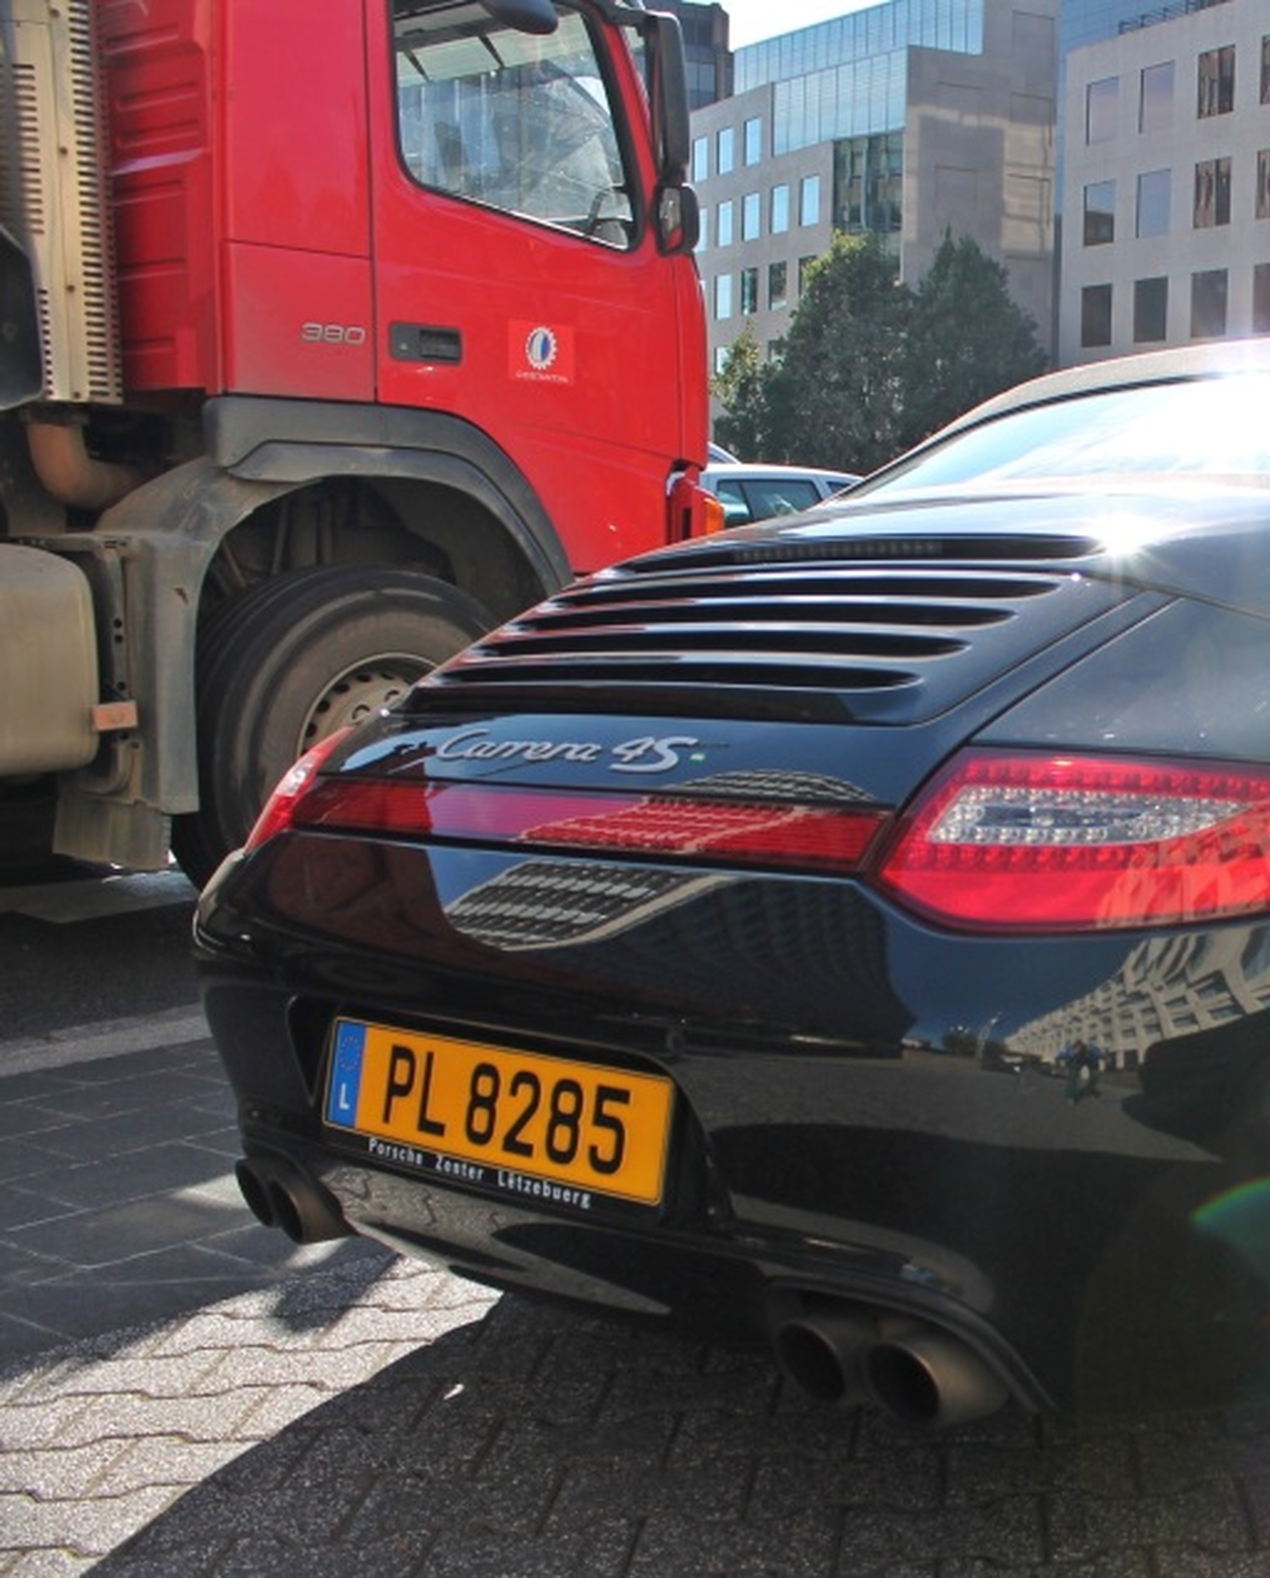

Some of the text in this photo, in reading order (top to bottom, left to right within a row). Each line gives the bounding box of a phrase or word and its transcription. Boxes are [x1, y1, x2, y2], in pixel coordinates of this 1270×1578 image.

[302, 322, 366, 345] 380
[437, 729, 698, 773] Carrera 4S
[338, 1083, 350, 1110] L
[382, 1044, 631, 1174] PL 8285
[368, 1137, 423, 1165] Porsche
[434, 1155, 485, 1181] Zenter
